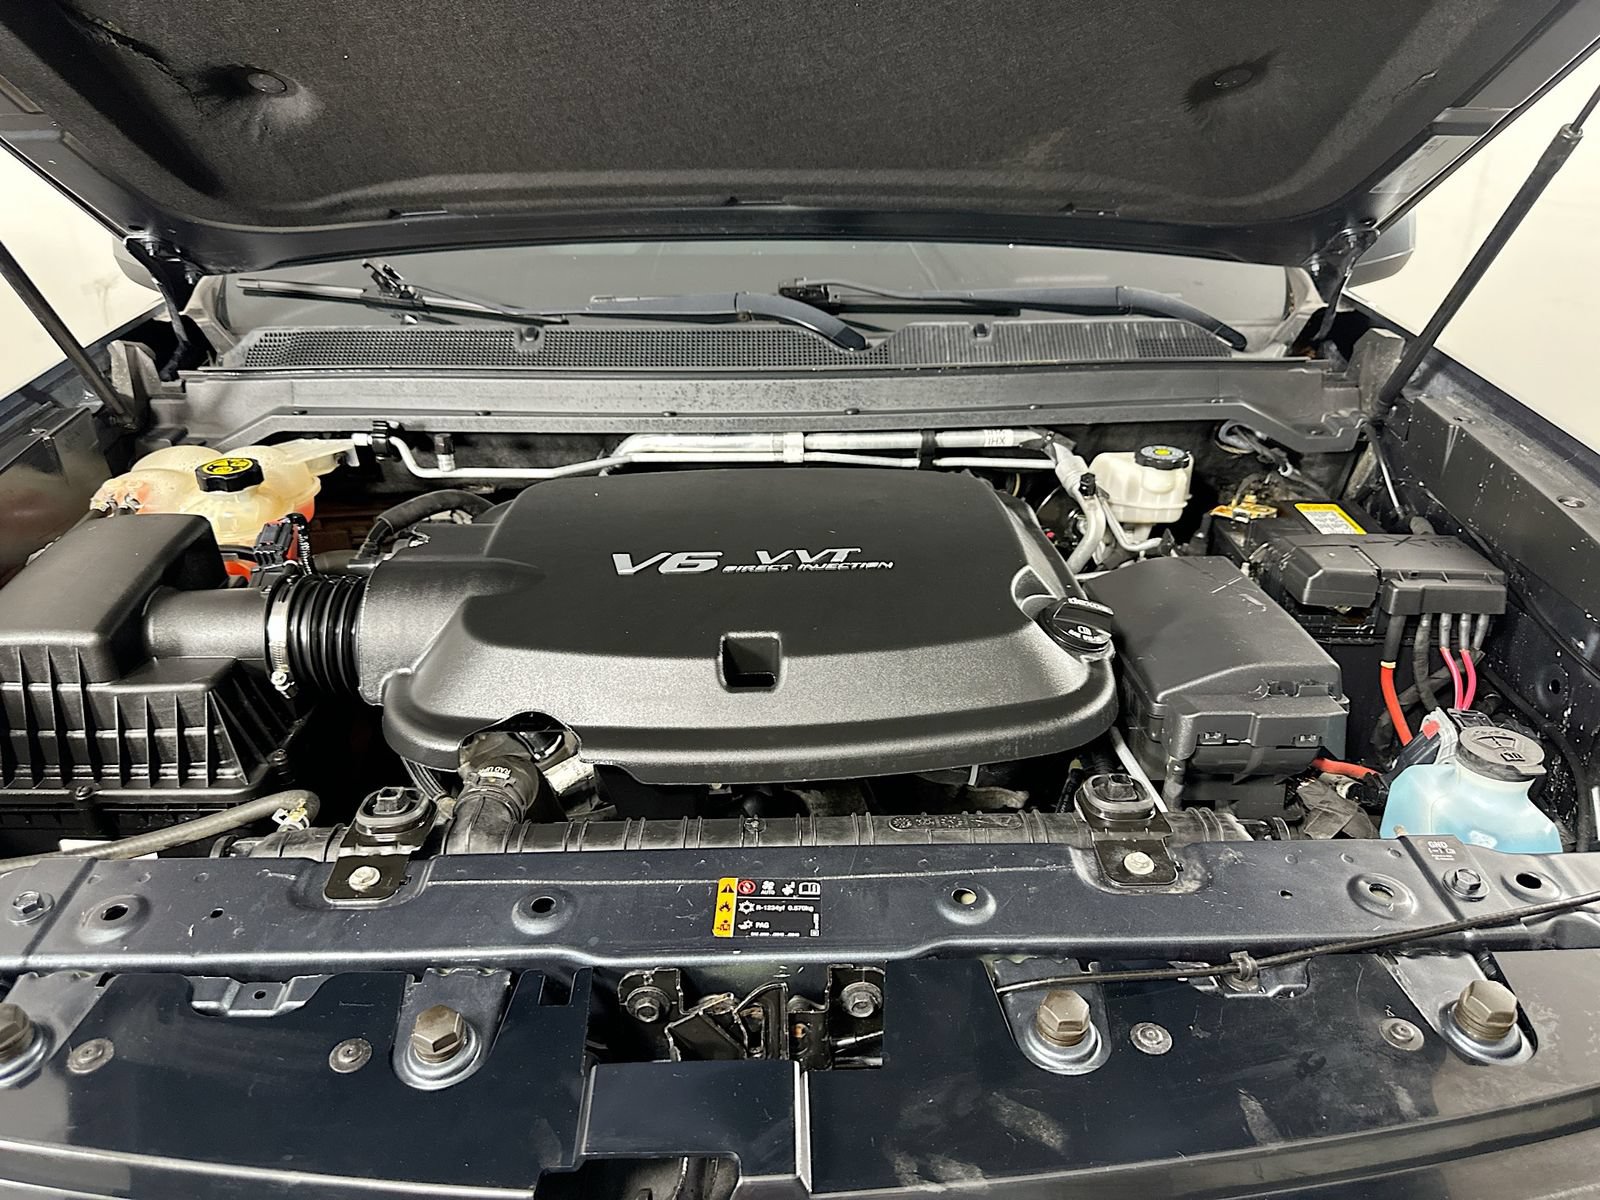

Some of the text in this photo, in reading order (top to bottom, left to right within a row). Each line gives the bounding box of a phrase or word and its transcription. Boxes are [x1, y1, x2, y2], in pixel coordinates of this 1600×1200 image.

[612, 548, 861, 576] V6 VVT
[722, 561, 894, 574] DIRECT INJECTION
[494, 766, 512, 776] RAD
[756, 904, 785, 912] R-1234yf
[755, 921, 770, 929] PAG
